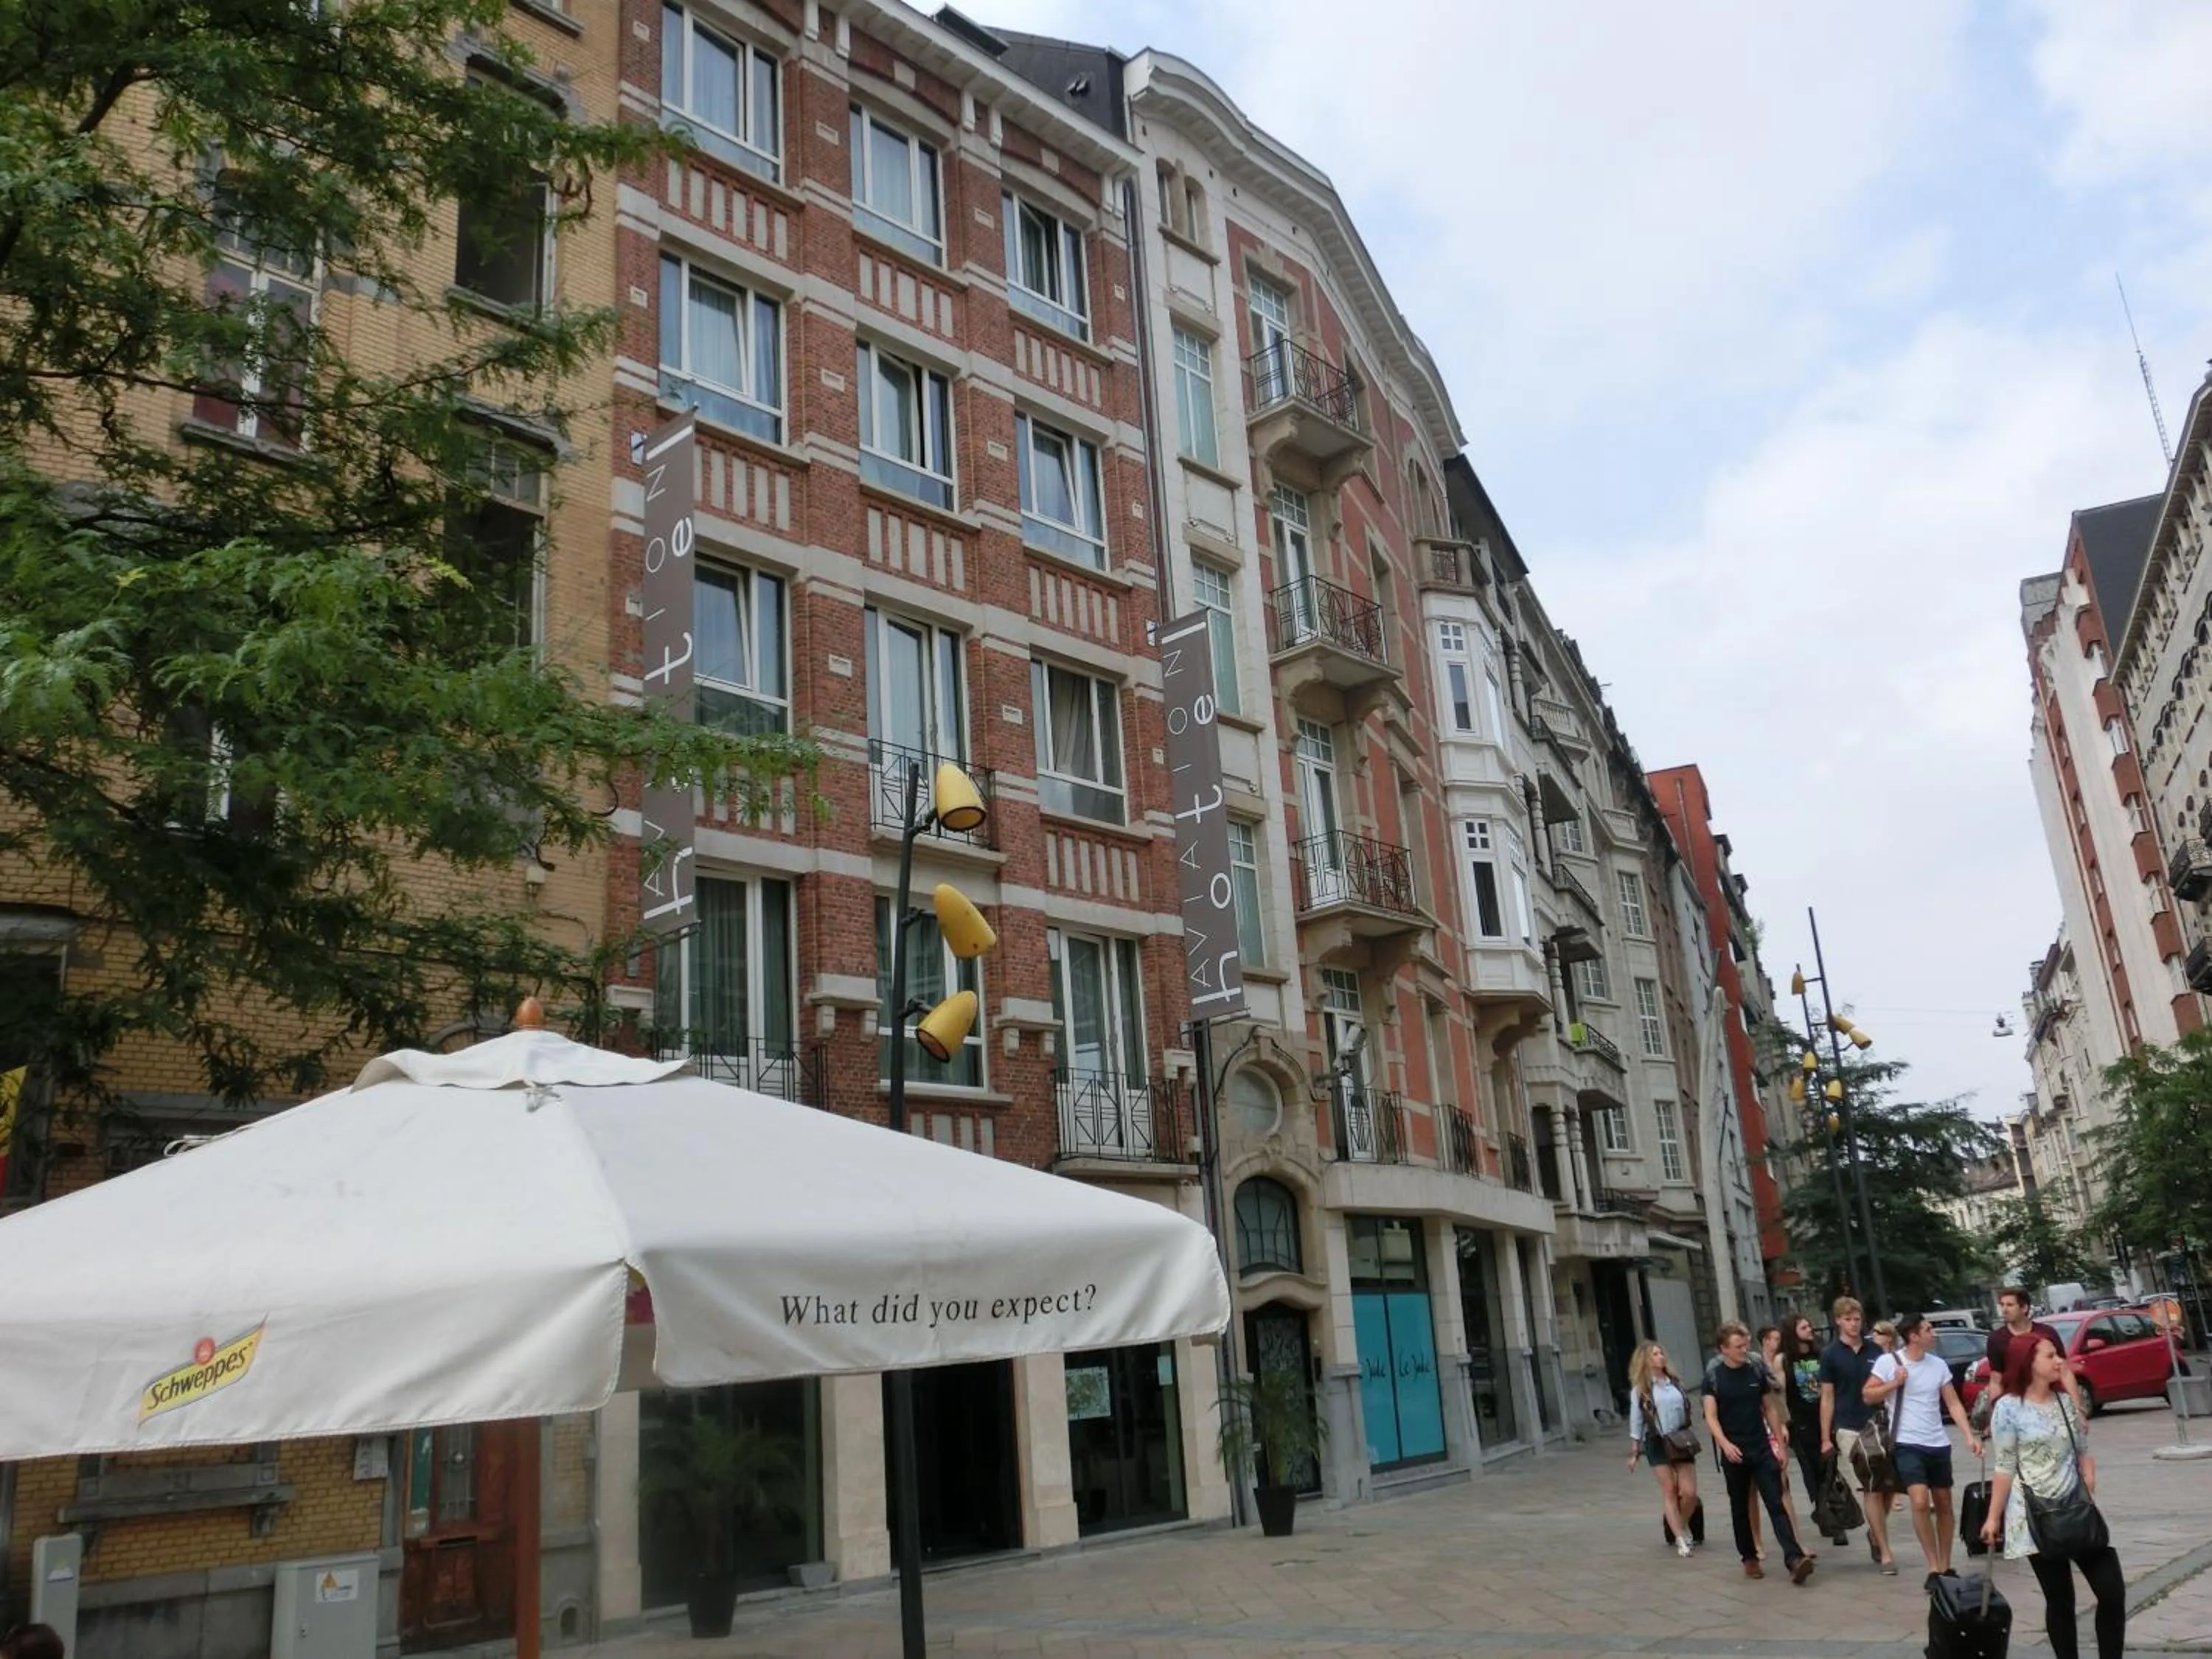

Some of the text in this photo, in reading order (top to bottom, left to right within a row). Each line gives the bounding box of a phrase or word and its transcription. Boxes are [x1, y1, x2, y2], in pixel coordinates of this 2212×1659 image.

[644, 425, 692, 919] htel
[1161, 622, 1242, 1004] hotel
[147, 1346, 248, 1411] Schweppes
[781, 1284, 1097, 1327] What did you expect?
